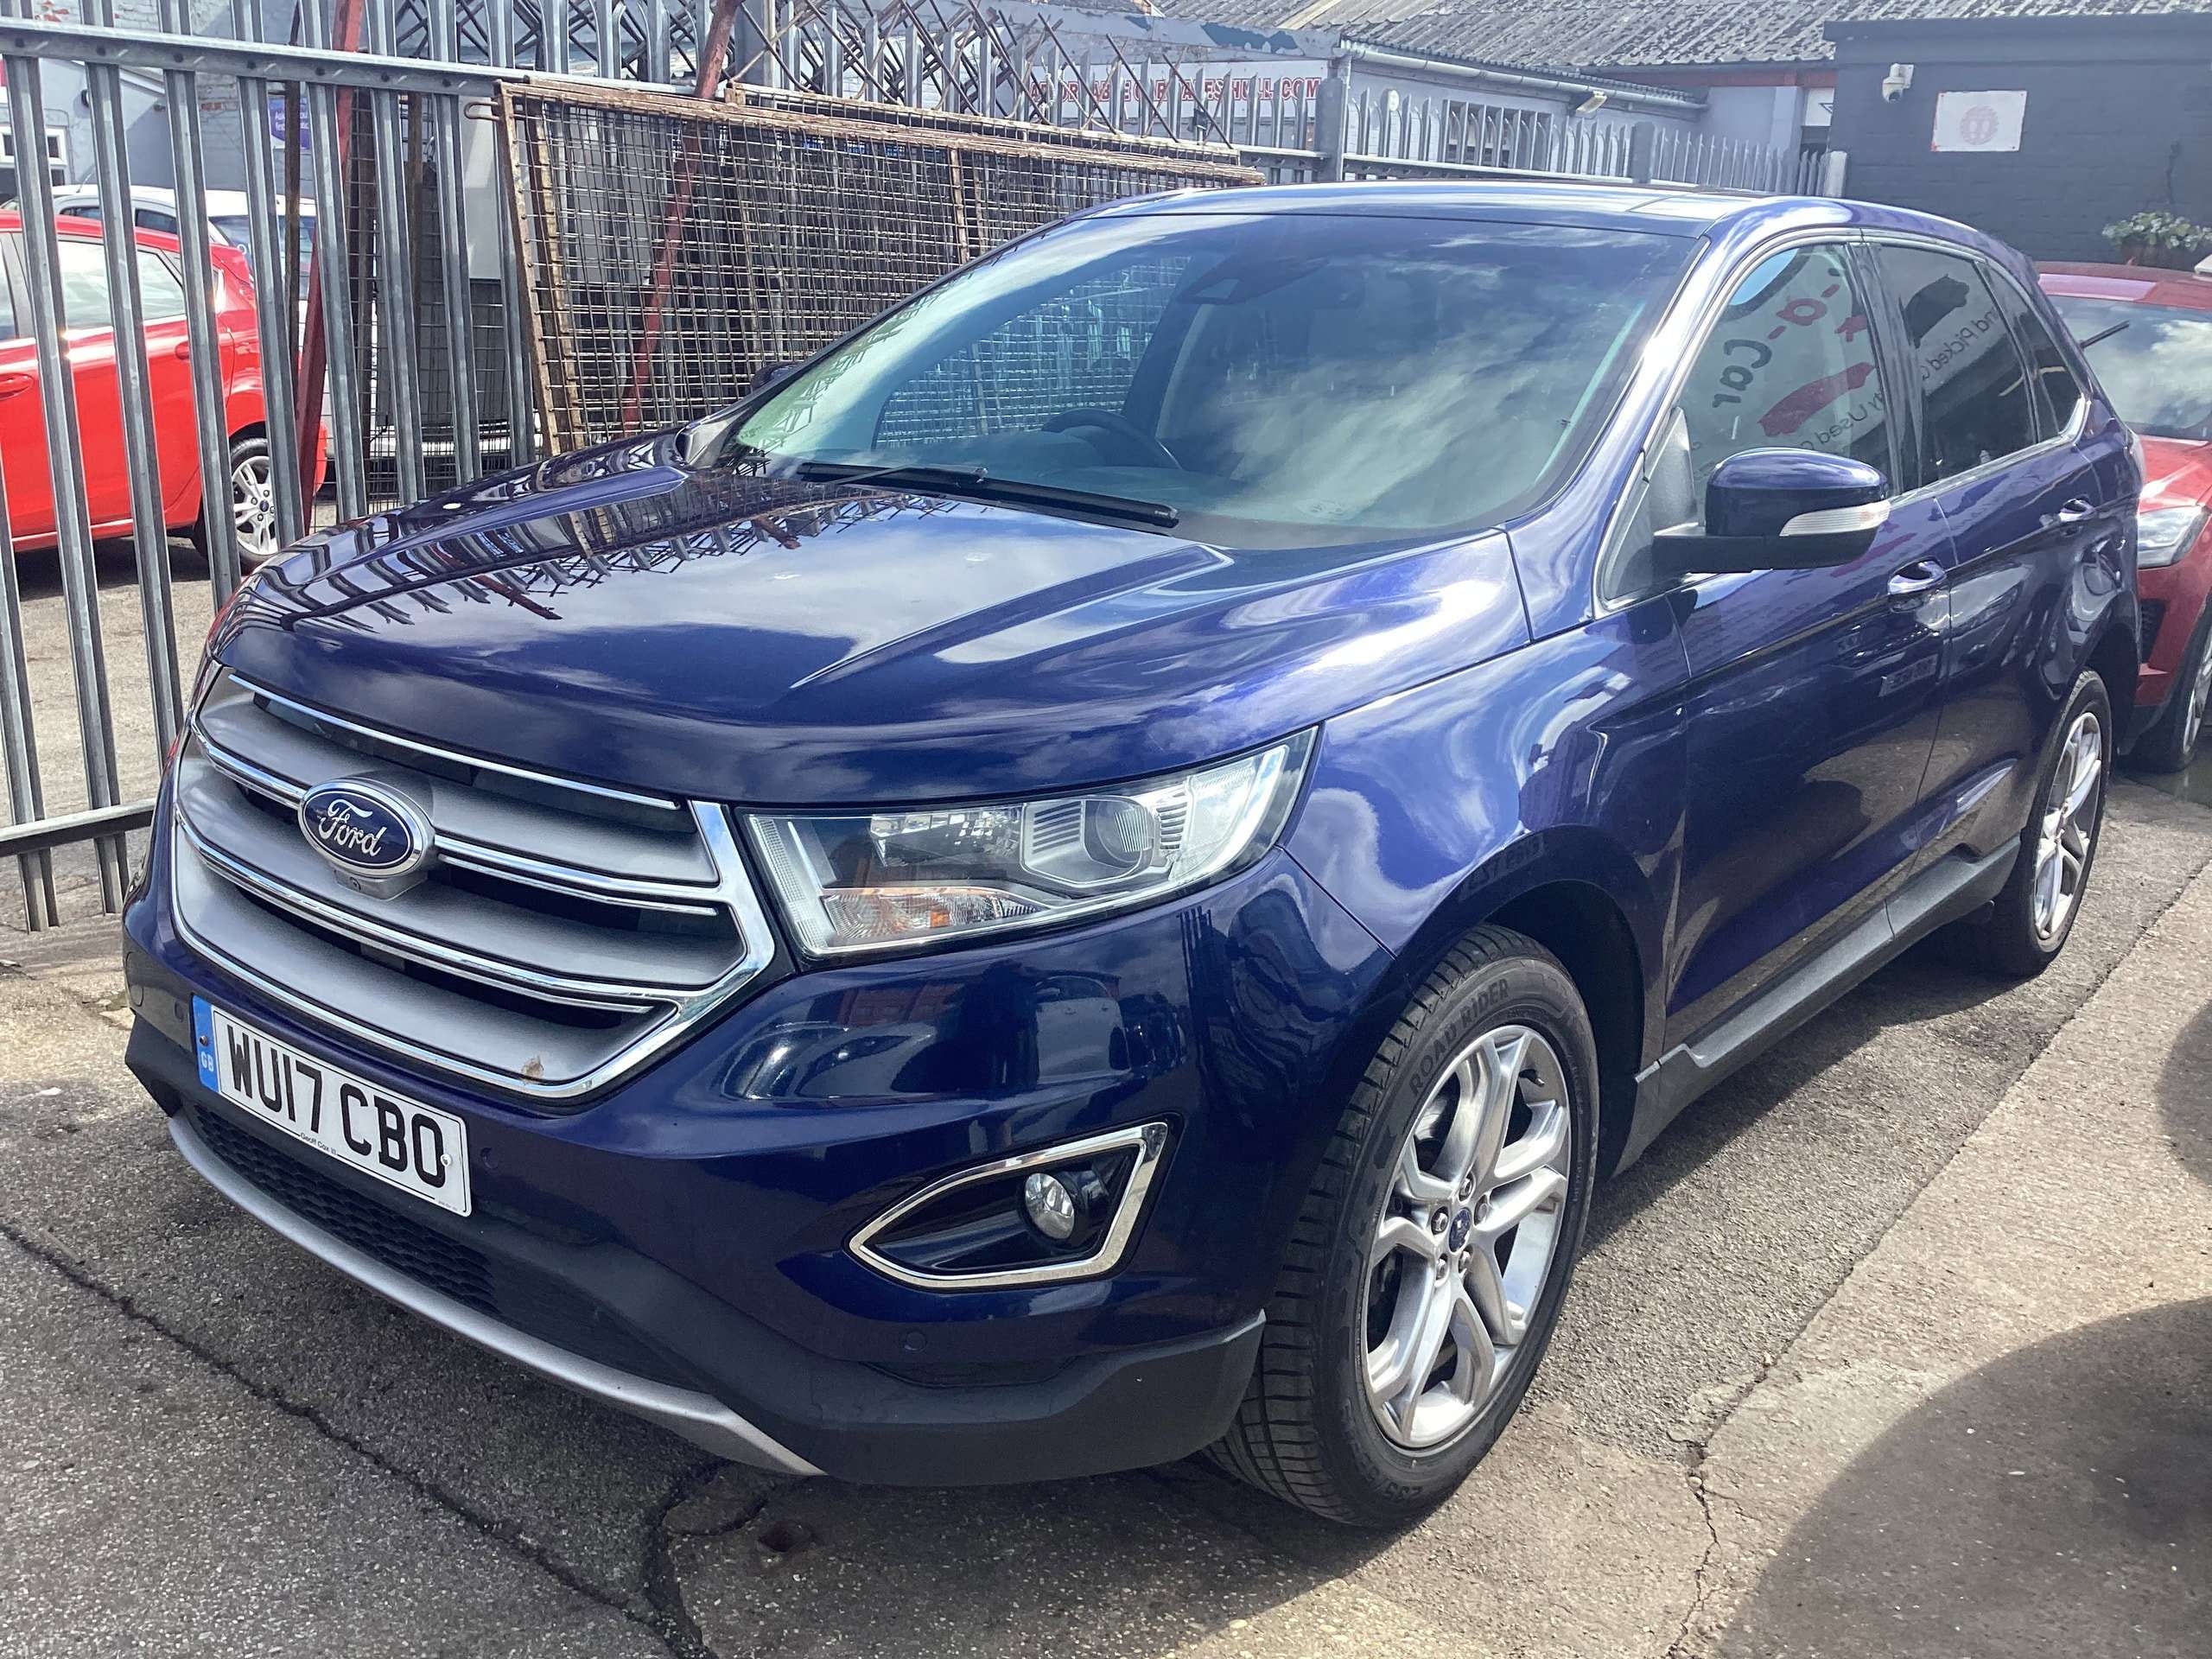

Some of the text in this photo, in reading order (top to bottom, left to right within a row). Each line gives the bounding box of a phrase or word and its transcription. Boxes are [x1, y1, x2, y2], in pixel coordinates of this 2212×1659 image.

[318, 798, 387, 856] Ford
[200, 1051, 214, 1072] GB
[1408, 978, 1510, 1096] ROAD RIDER
[227, 1024, 446, 1188] WU17 CBO
